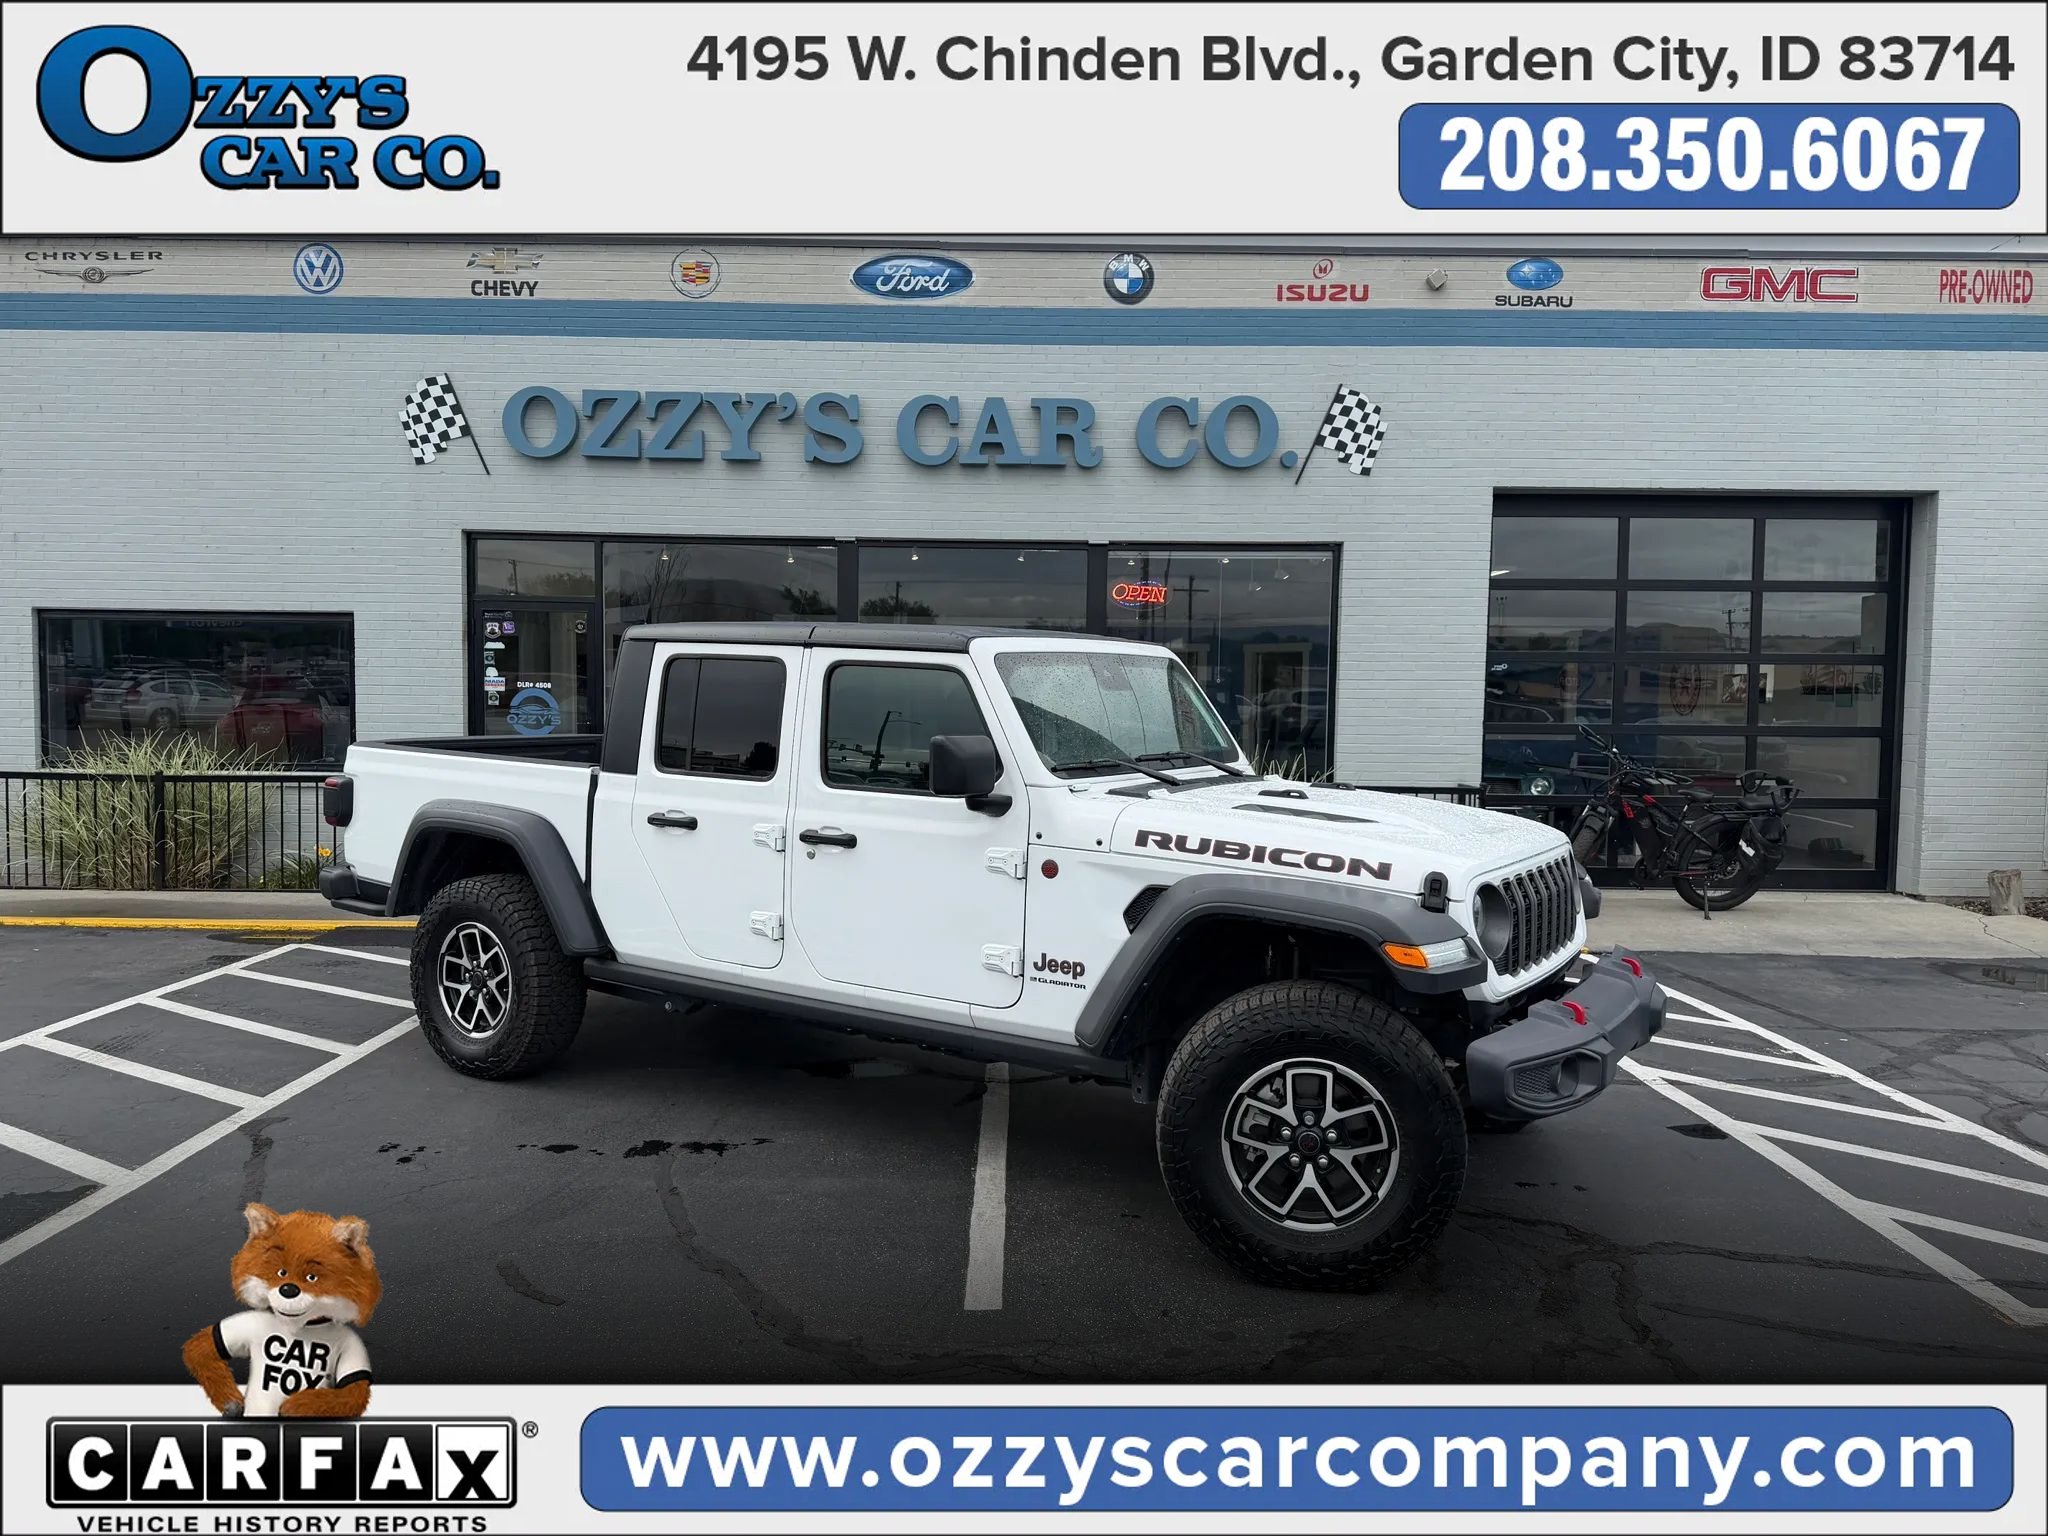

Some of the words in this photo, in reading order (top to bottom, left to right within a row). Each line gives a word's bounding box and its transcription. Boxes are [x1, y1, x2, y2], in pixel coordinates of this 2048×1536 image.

[25, 251, 163, 261] CHRYSLER
[876, 259, 950, 292] Ford
[1701, 267, 1858, 302] GMC
[471, 280, 538, 297] CHEVY
[1277, 284, 1369, 302] ISUZU
[1938, 269, 2034, 304] PRE-OWNED
[1495, 295, 1573, 308] SUBARU
[502, 386, 863, 465] OZZY'S
[896, 395, 1103, 469] CAR
[1136, 395, 1299, 470] CO.
[1112, 583, 1168, 603] OPEN
[507, 714, 561, 725] OZZY'S
[1134, 829, 1393, 881] RUBICON
[1033, 952, 1085, 980] Jeep
[1038, 977, 1086, 990] GLADIATOR
